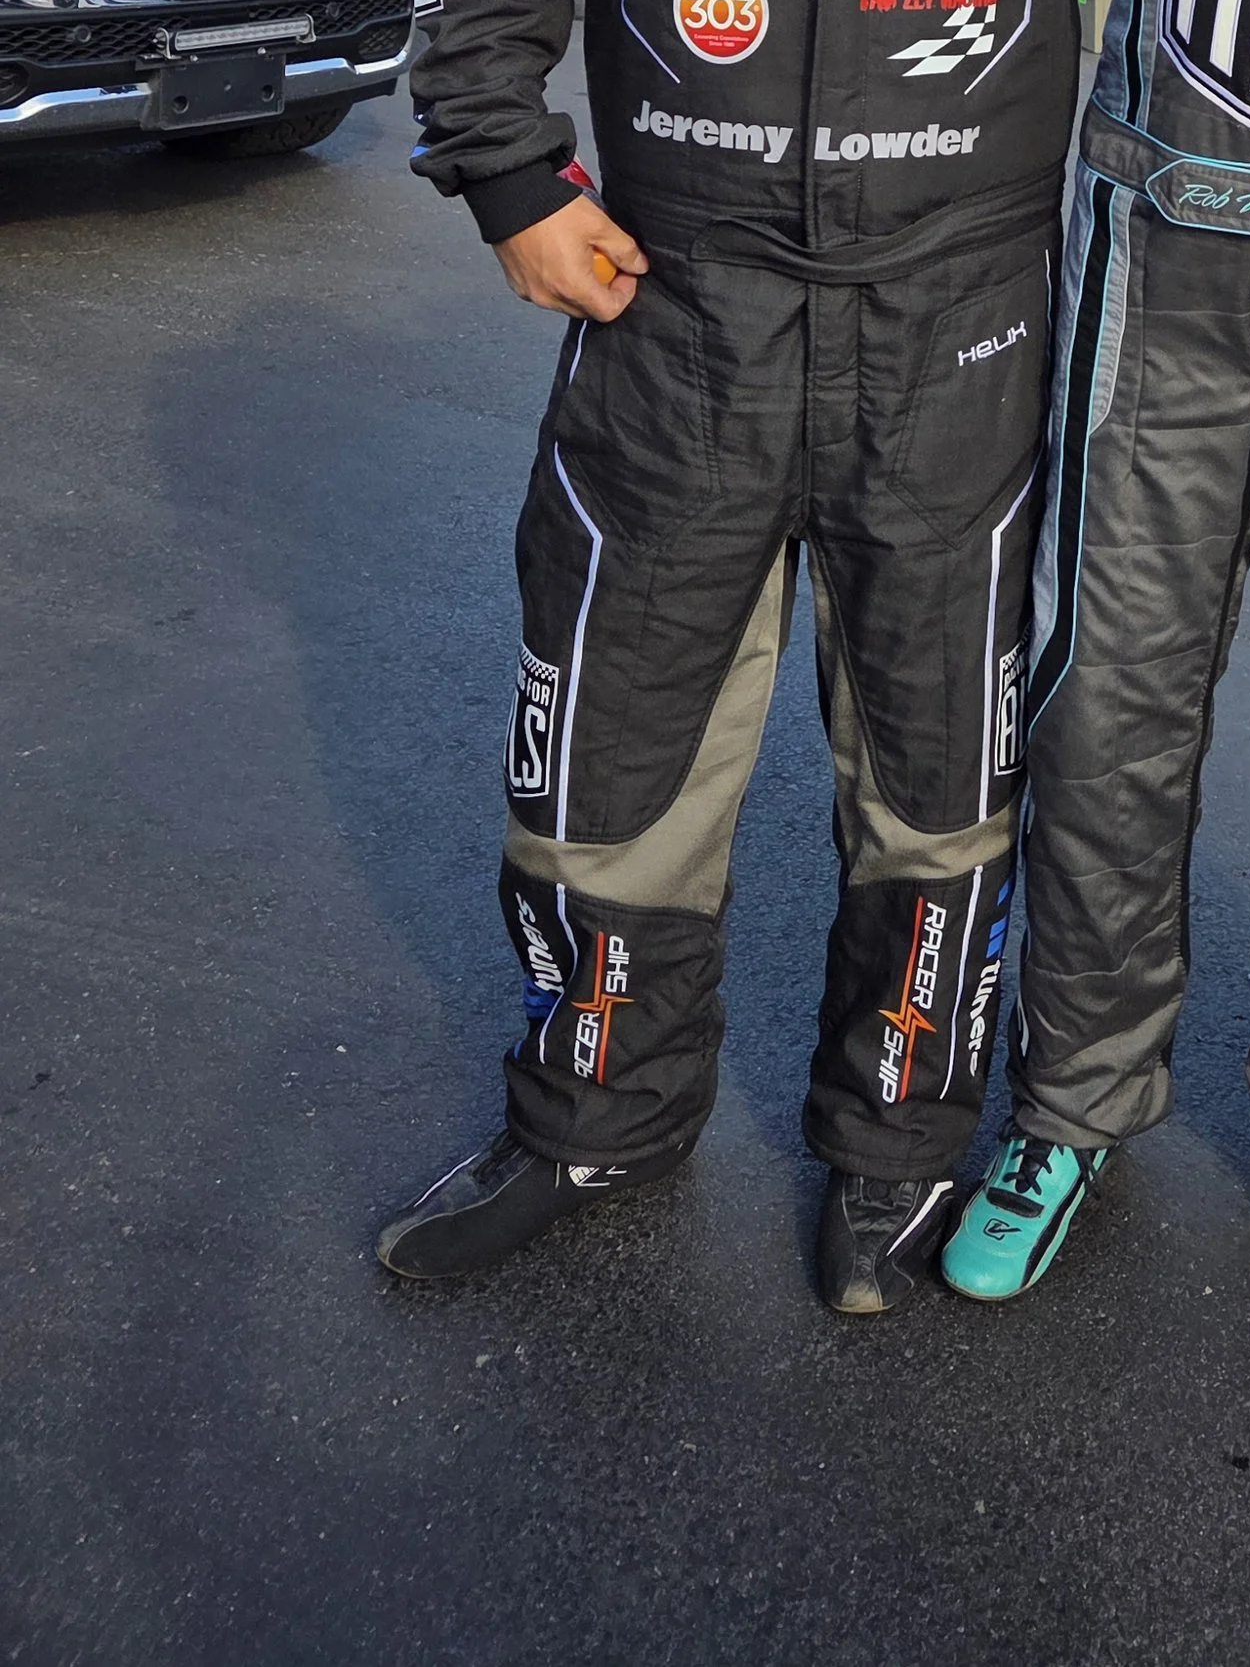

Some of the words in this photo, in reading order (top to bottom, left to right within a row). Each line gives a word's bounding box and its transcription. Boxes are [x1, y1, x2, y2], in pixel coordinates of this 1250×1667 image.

[633, 100, 794, 164] Jeremy
[814, 123, 981, 161] Lowder
[1178, 184, 1234, 210] Rob
[604, 935, 630, 994] SHIP
[912, 901, 946, 1011] RACER
[573, 1012, 601, 1080] ACER
[880, 1028, 904, 1104] SHIP
